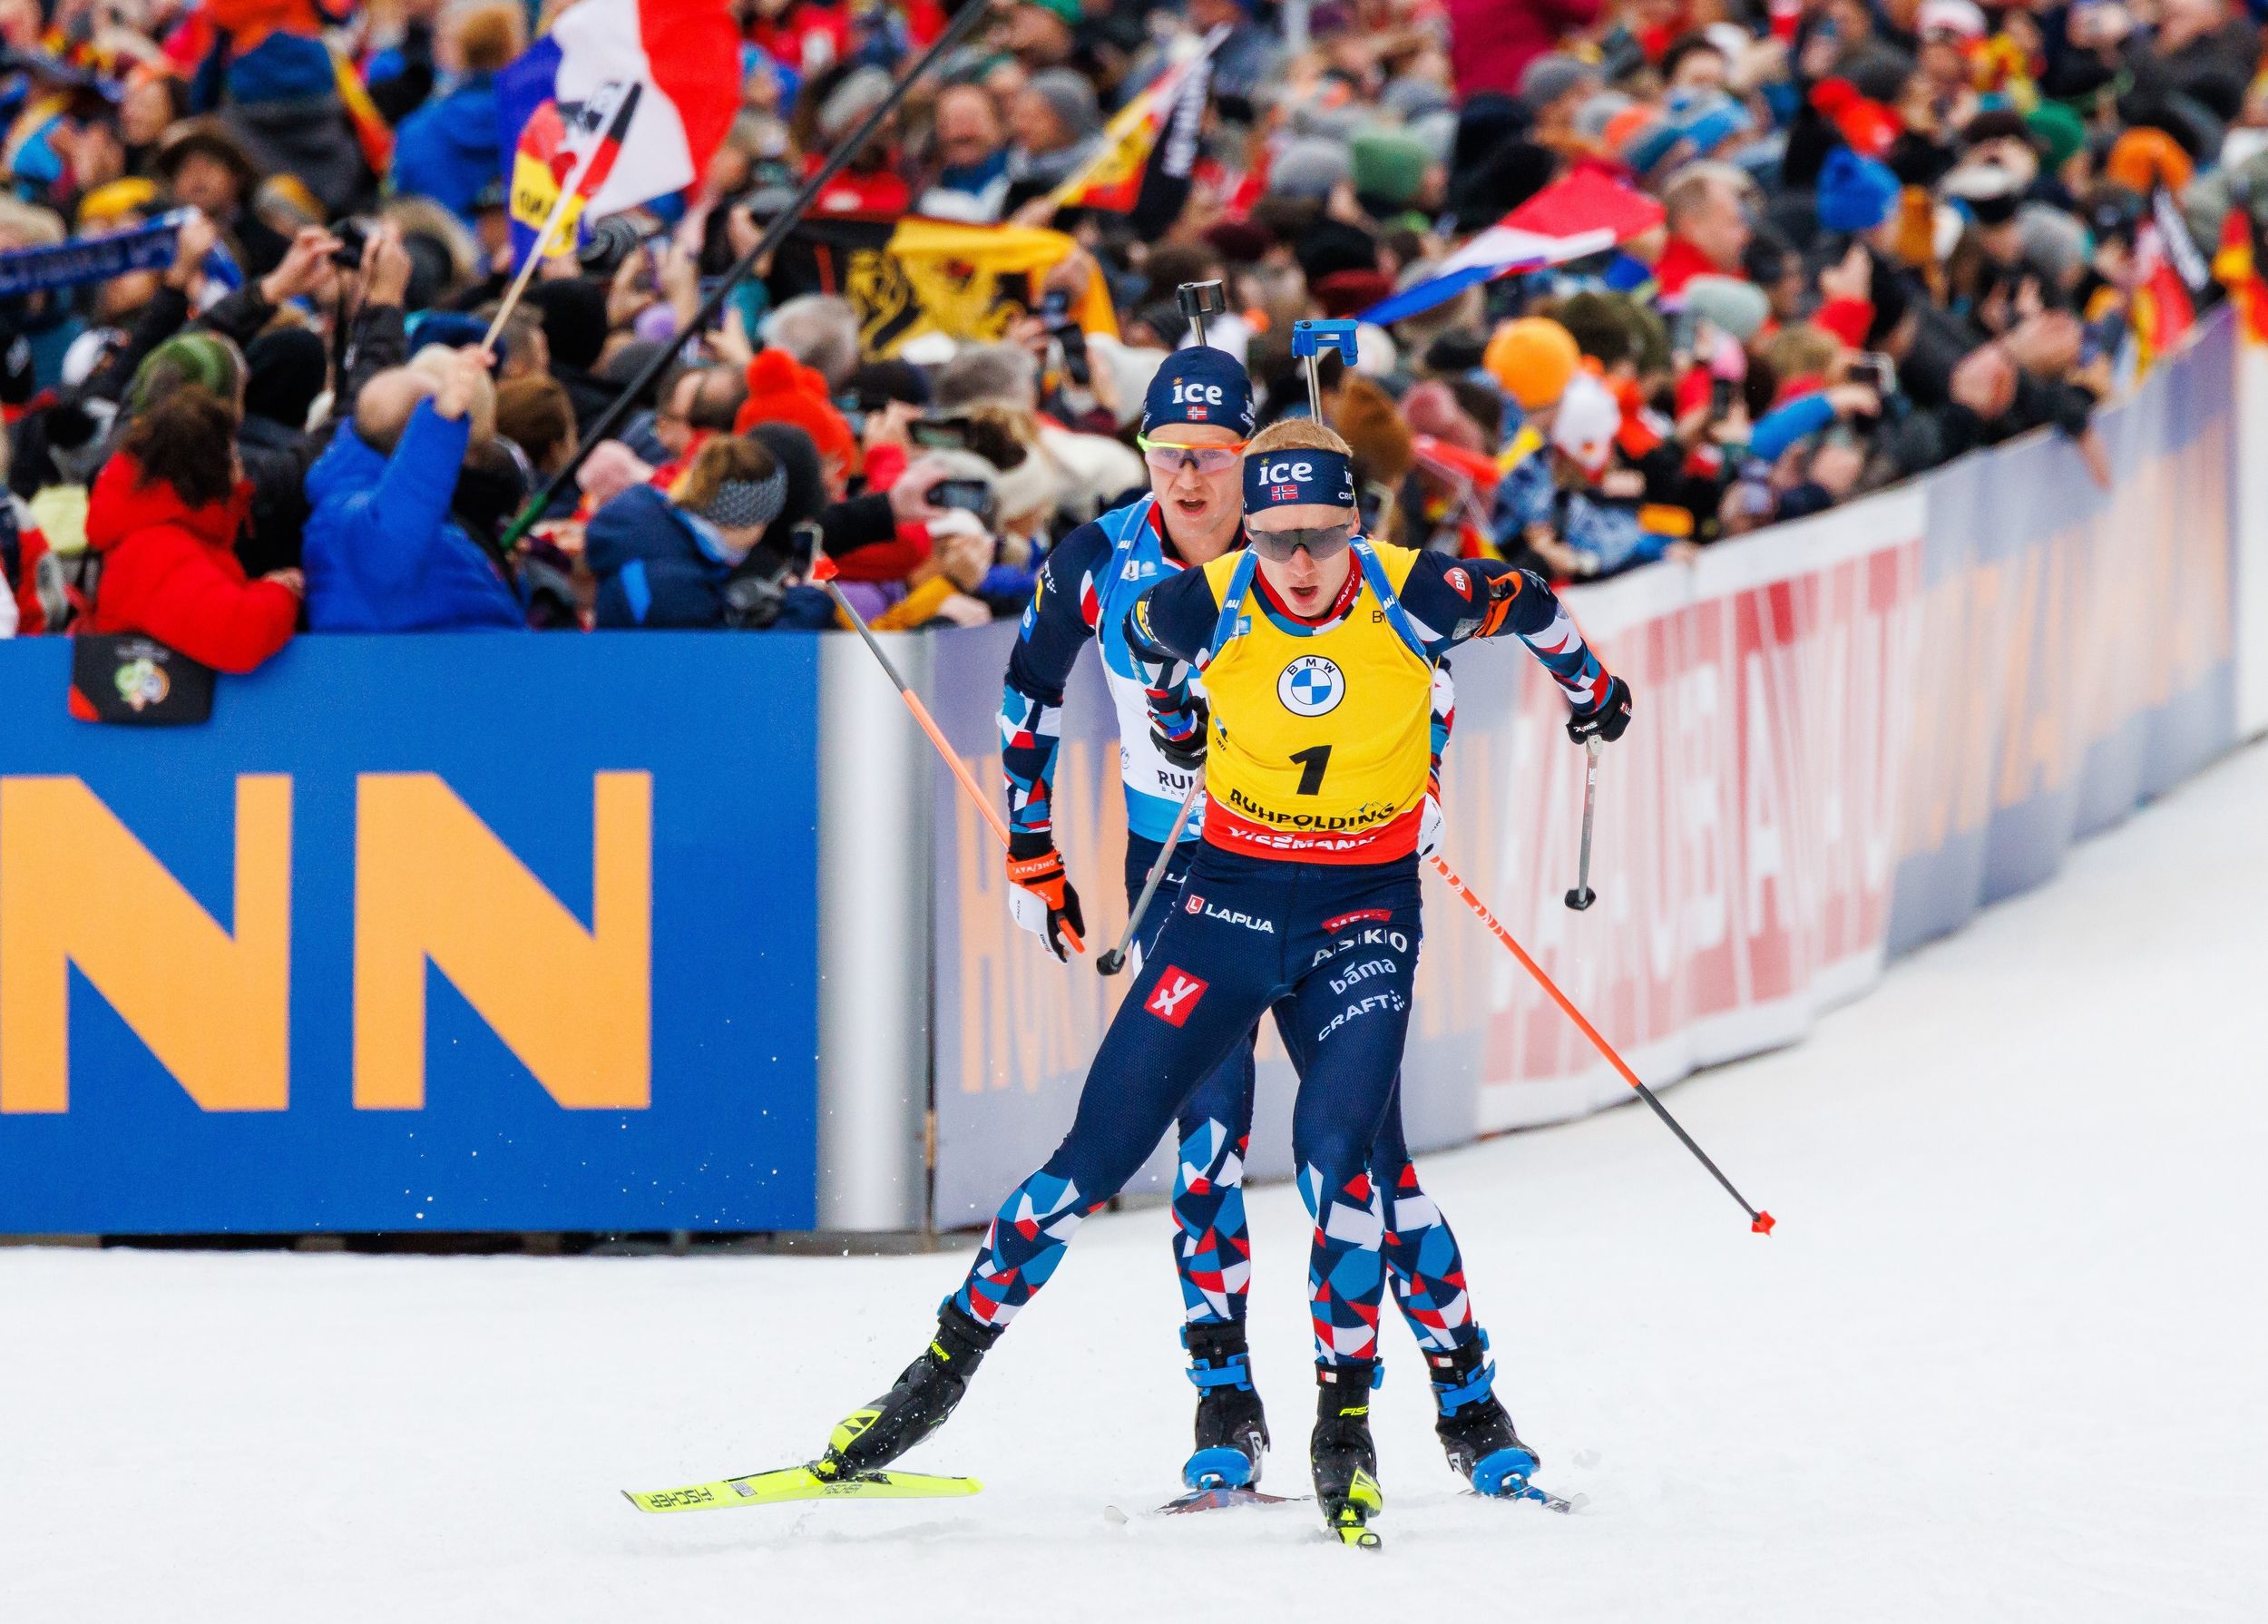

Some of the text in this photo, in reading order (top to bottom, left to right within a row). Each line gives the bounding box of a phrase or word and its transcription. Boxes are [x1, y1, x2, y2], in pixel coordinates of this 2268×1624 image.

[1172, 377, 1223, 406] ice
[1258, 458, 1313, 486] ice
[1286, 658, 1336, 676] BMW
[1288, 744, 1333, 796] 1
[1229, 788, 1395, 830] RUHPOLDING
[1205, 904, 1275, 934] LAPUA
[0, 769, 653, 1114] NN
[1317, 994, 1389, 1042] CRAFT
